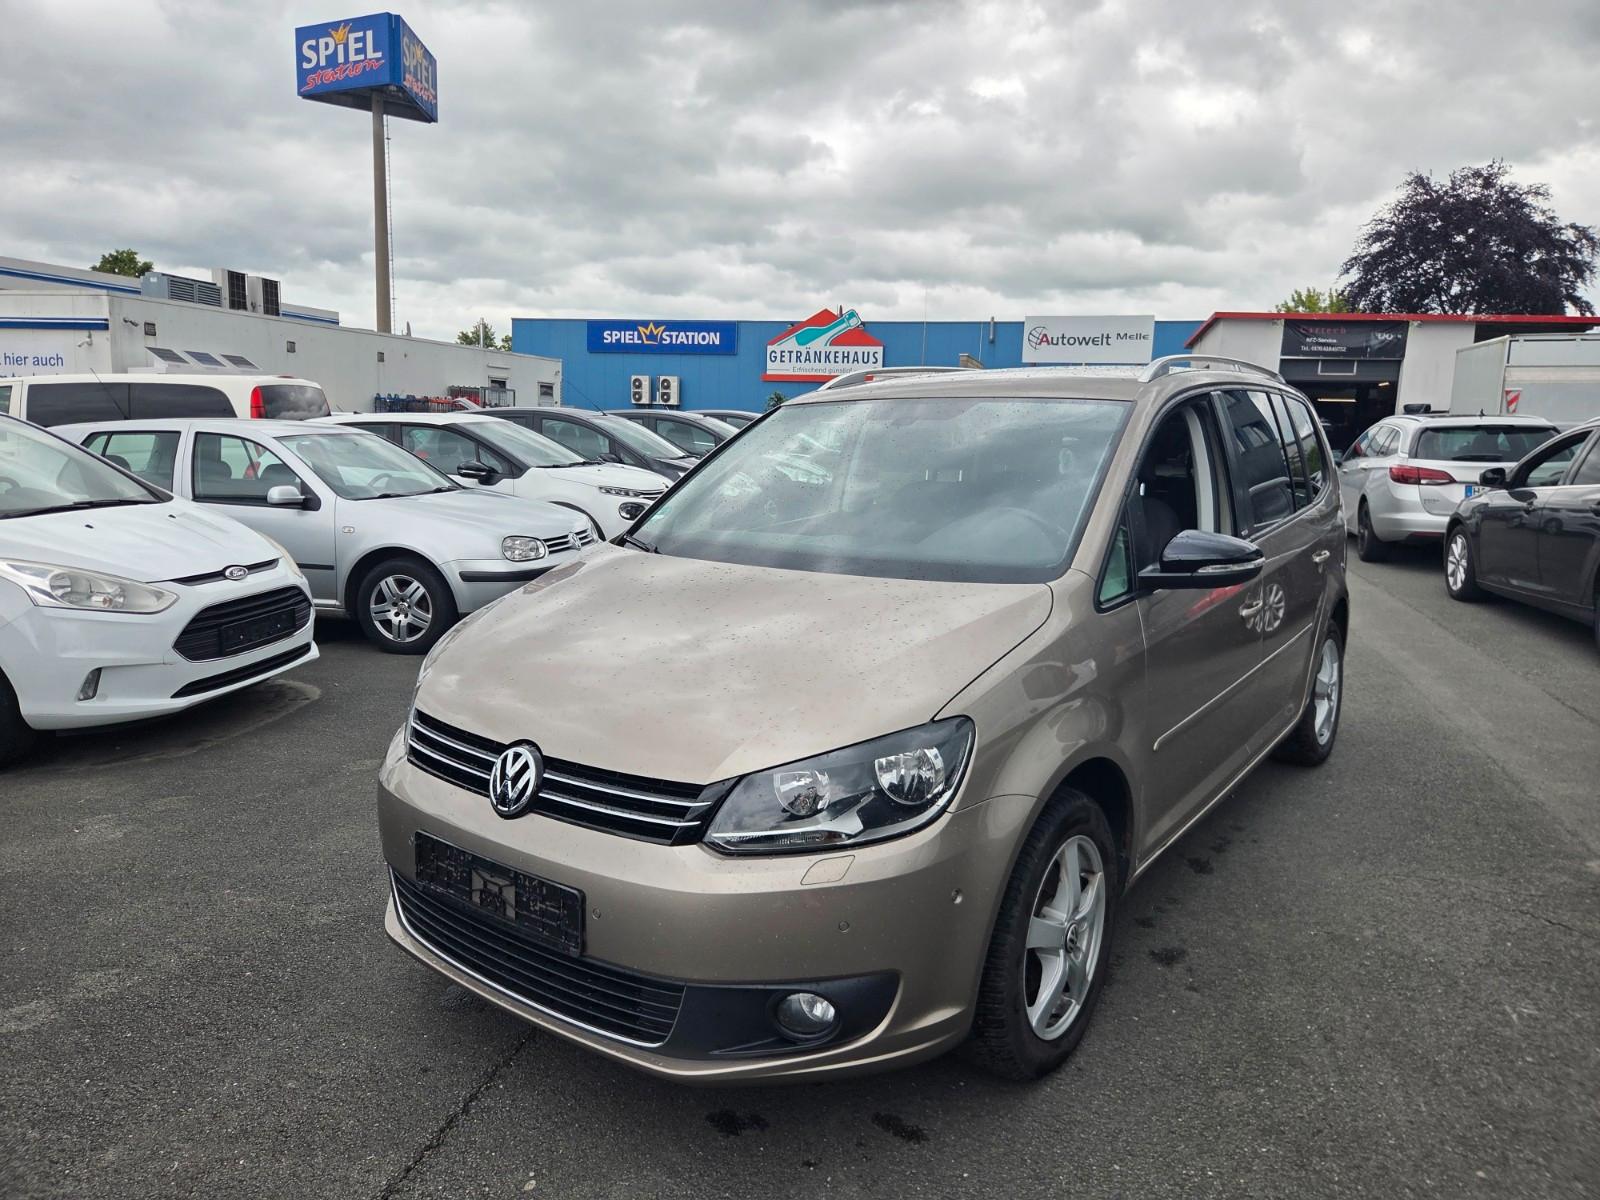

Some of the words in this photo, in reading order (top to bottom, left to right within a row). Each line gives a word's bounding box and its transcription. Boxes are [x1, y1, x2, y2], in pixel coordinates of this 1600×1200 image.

[603, 330, 642, 343] SPIEL
[662, 331, 720, 345] STATION
[1038, 333, 1111, 346] Autowelt
[1116, 332, 1150, 340] Melle
[4, 352, 29, 366] hier
[33, 353, 64, 367] auch
[769, 347, 879, 364] GETRÄNKEHAUS
